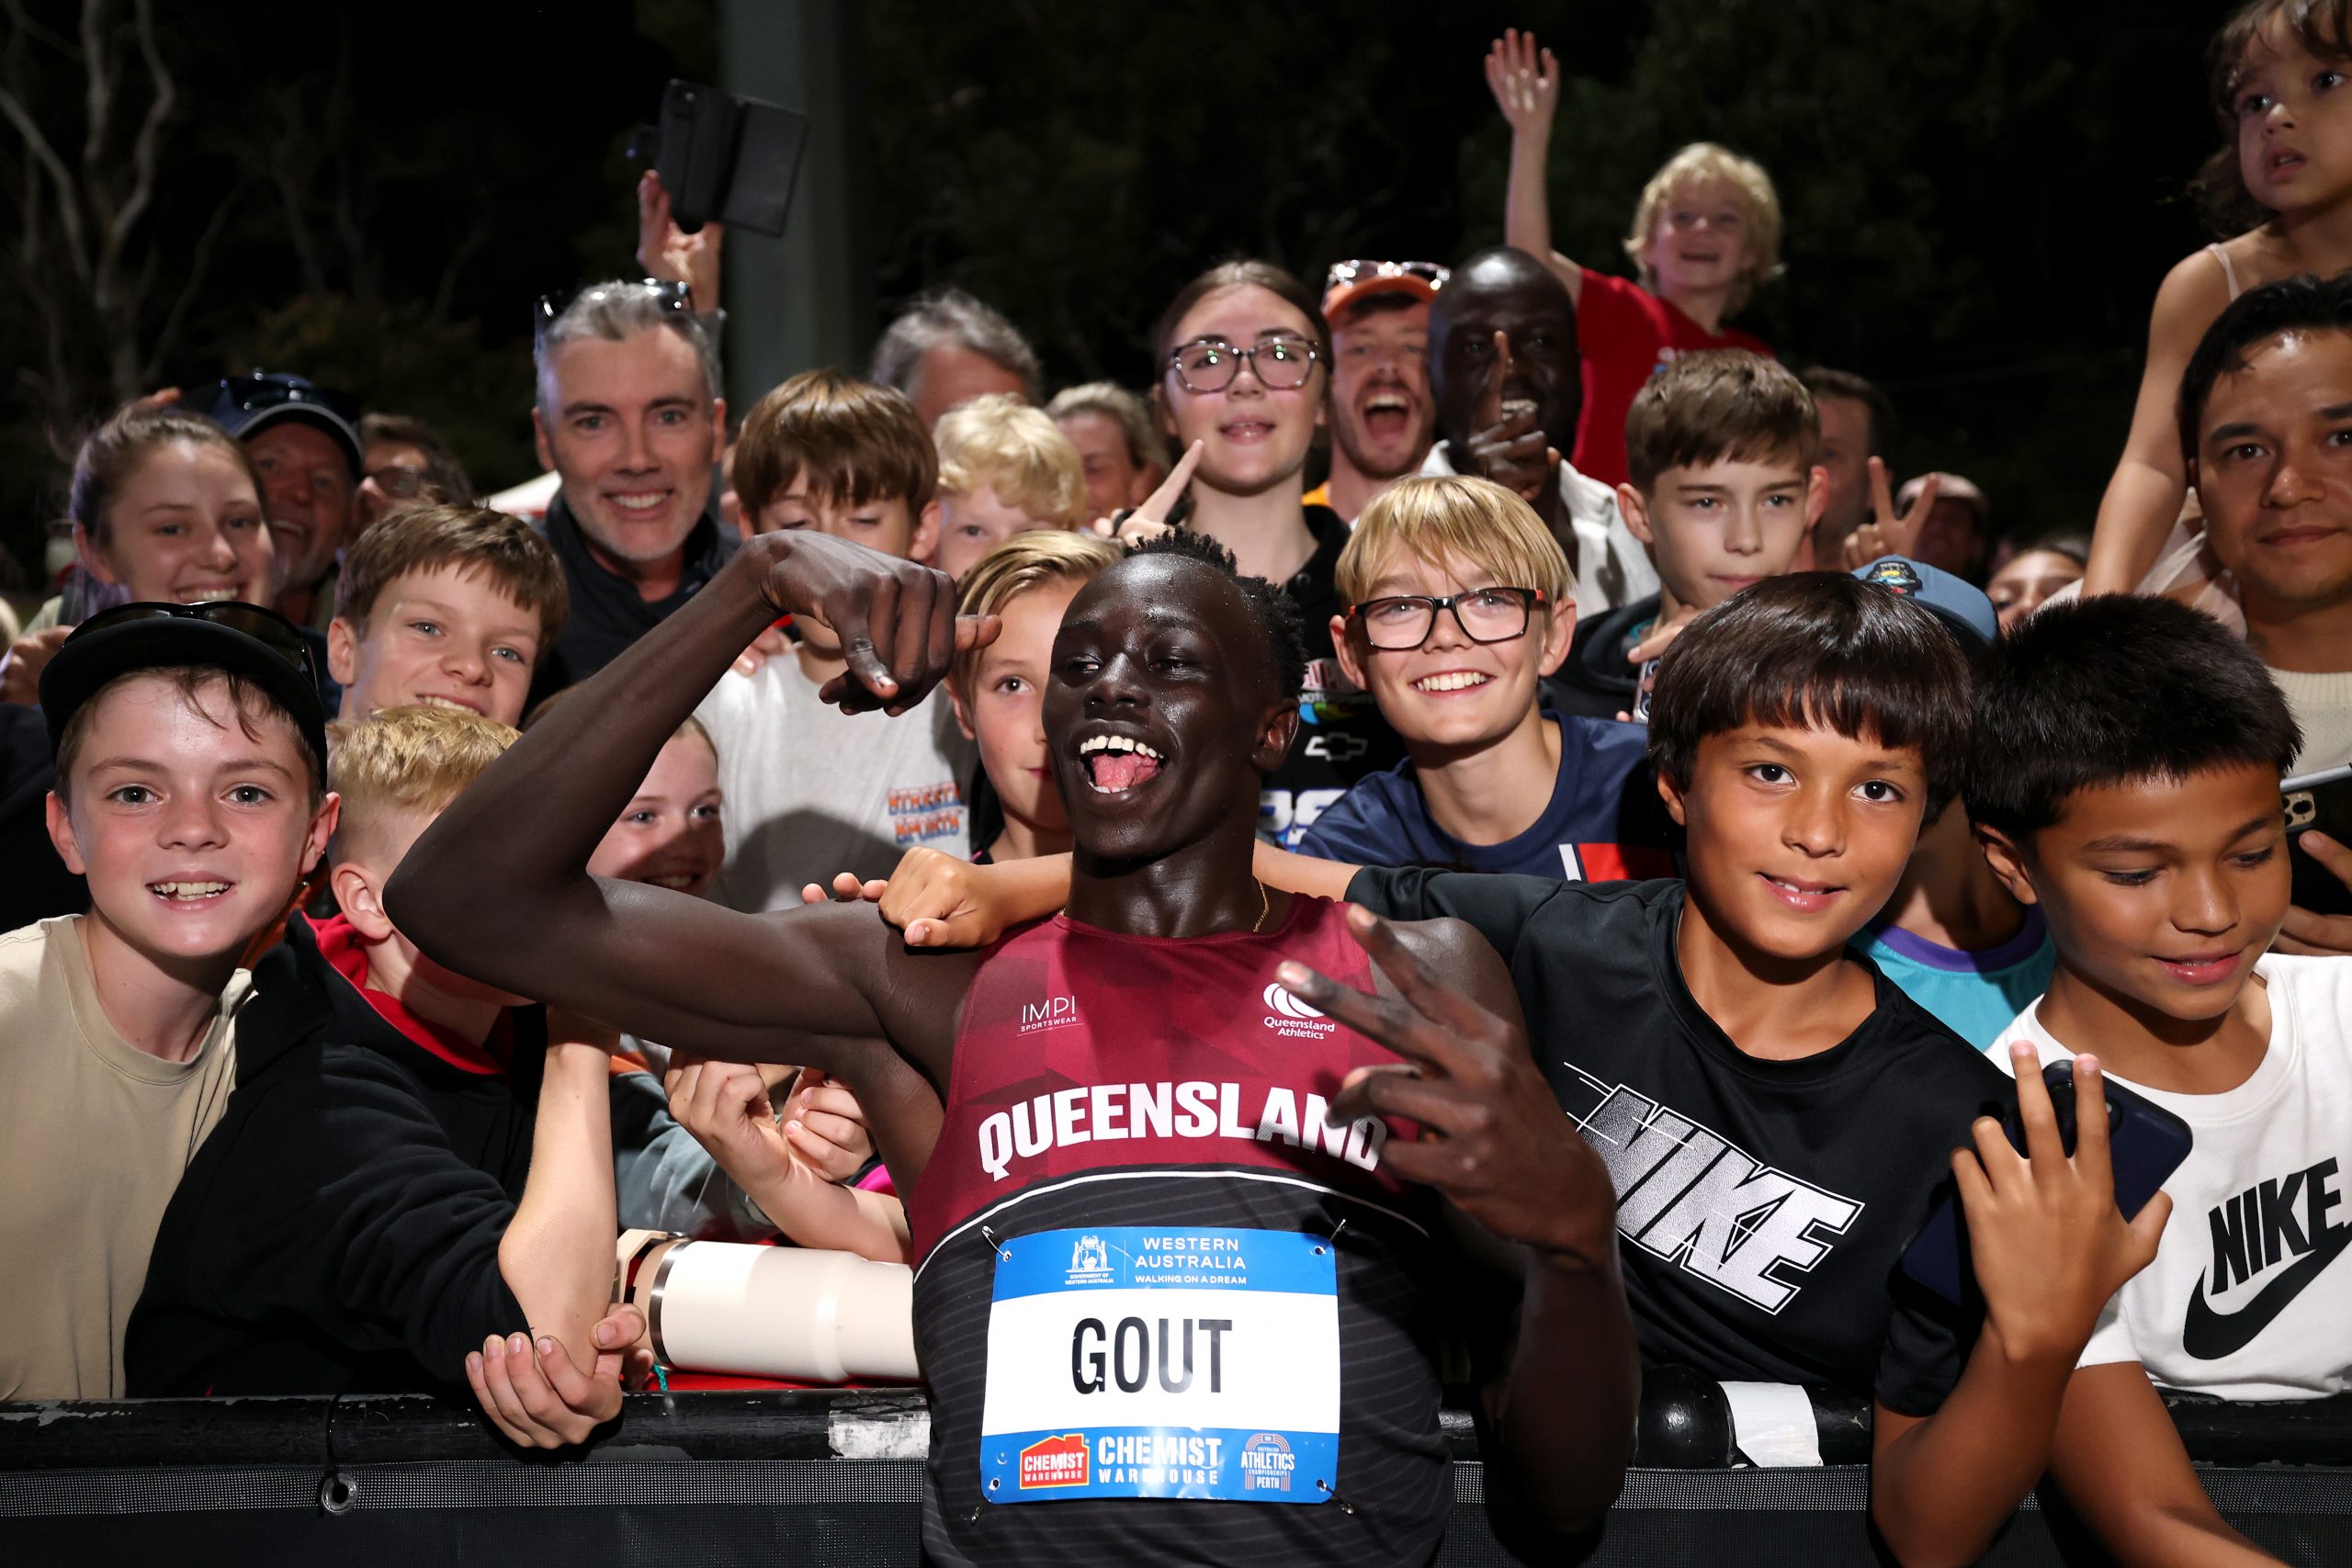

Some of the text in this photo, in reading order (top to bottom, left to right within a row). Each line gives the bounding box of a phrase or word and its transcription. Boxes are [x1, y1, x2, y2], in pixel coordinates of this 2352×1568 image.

[1023, 995, 1076, 1023] IMPI
[1021, 1016, 1077, 1032] SPORTSWEAR
[1264, 1016, 1336, 1032] Queensland
[1277, 1027, 1325, 1040] Athletics
[978, 1081, 1387, 1182] QUEENSLAND
[1576, 1083, 1865, 1315] NIKE
[2208, 1156, 2345, 1296] NIKE
[1143, 1236, 1238, 1251] WESTERN
[1135, 1255, 1247, 1269] AUSTRALIA
[1135, 1275, 1247, 1284] WALKING ON A DREAM
[1071, 1316, 1233, 1394] GOUT
[1098, 1436, 1222, 1466] CHEMIST
[1024, 1452, 1084, 1472] CHEMIST
[1241, 1451, 1295, 1471] ATHLETICS
[1024, 1470, 1082, 1482] WAREHOUSE
[1099, 1468, 1217, 1484] WAROUSE
[1256, 1476, 1280, 1489] PERTH
